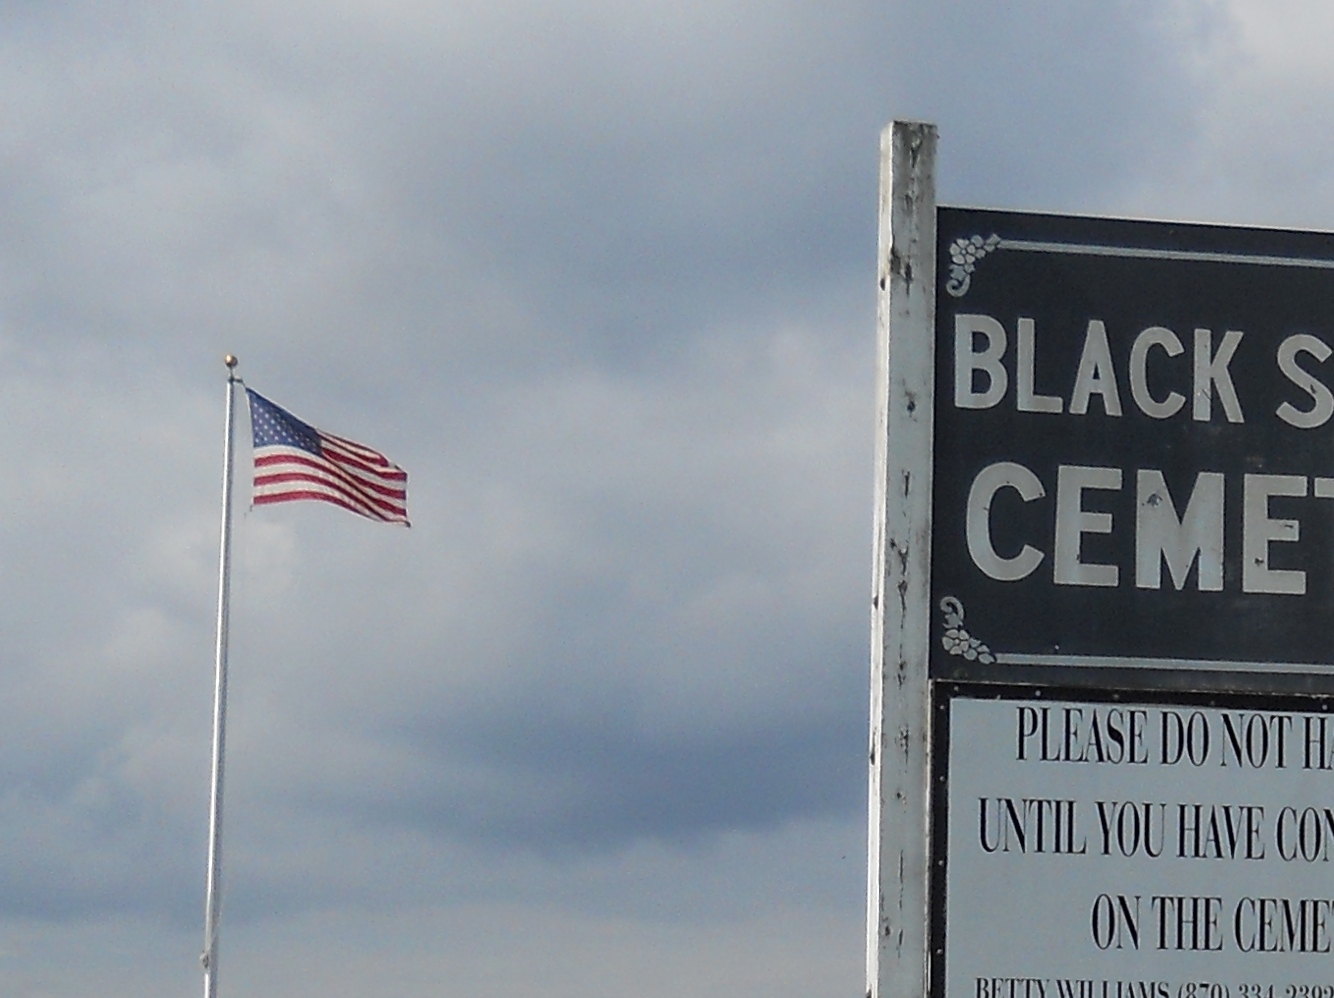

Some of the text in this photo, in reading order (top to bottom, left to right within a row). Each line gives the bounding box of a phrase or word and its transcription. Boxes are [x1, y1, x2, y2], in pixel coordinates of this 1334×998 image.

[954, 313, 1245, 424] BLACK
[1015, 706, 1149, 765] PLEASE
[1159, 710, 1210, 767] DO
[1219, 713, 1293, 769] NOT
[978, 797, 1087, 854] UNTIL
[1094, 801, 1167, 858] YOU
[1175, 804, 1266, 860] HAVE
[1091, 893, 1142, 950] ON
[1151, 896, 1224, 951] THE
